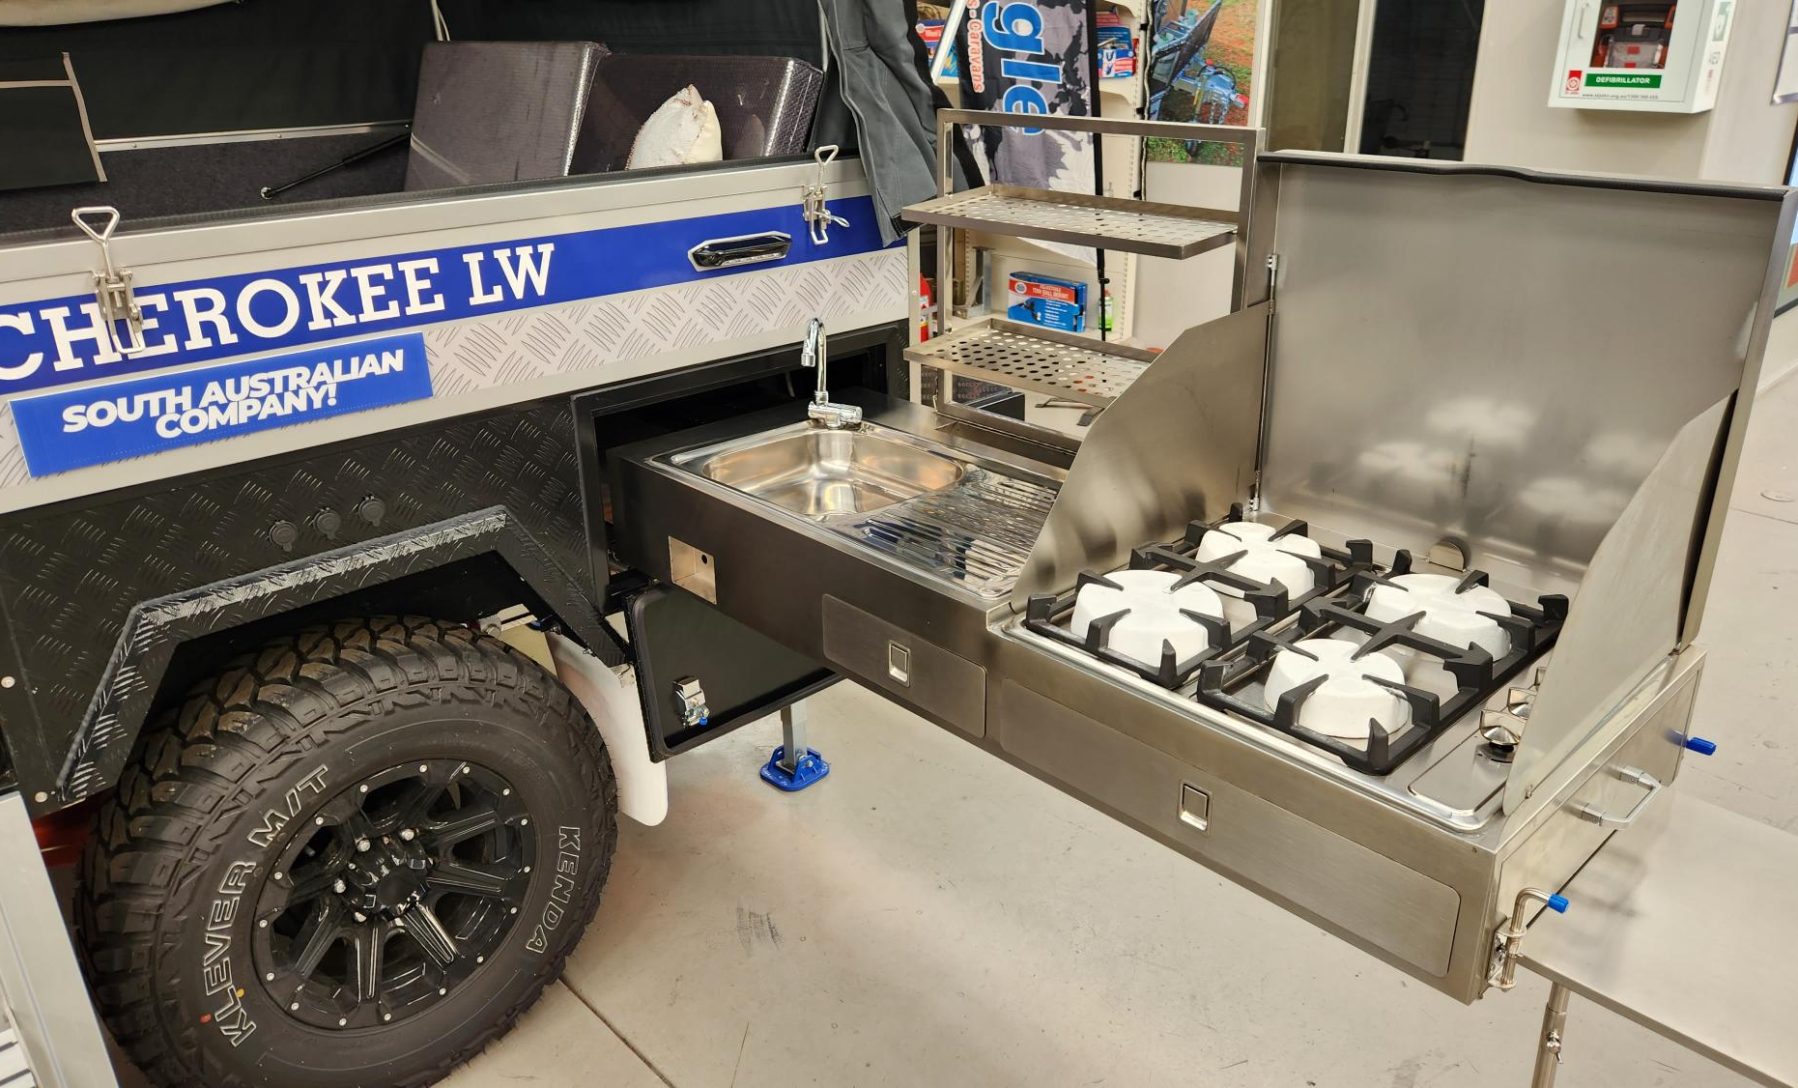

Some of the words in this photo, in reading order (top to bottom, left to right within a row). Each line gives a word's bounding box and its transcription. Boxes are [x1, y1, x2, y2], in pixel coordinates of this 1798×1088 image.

[1595, 76, 1650, 84] DEFIBRILLATOR
[0, 257, 446, 381] CHEROKEE
[462, 243, 556, 306] LW
[62, 382, 197, 434] SOUTH
[200, 349, 404, 410] AUSTRALIAN
[155, 383, 338, 440] COMPANY!
[203, 860, 257, 1048] KLEVER
[248, 764, 329, 848] M/T
[525, 825, 581, 955] KENDA
